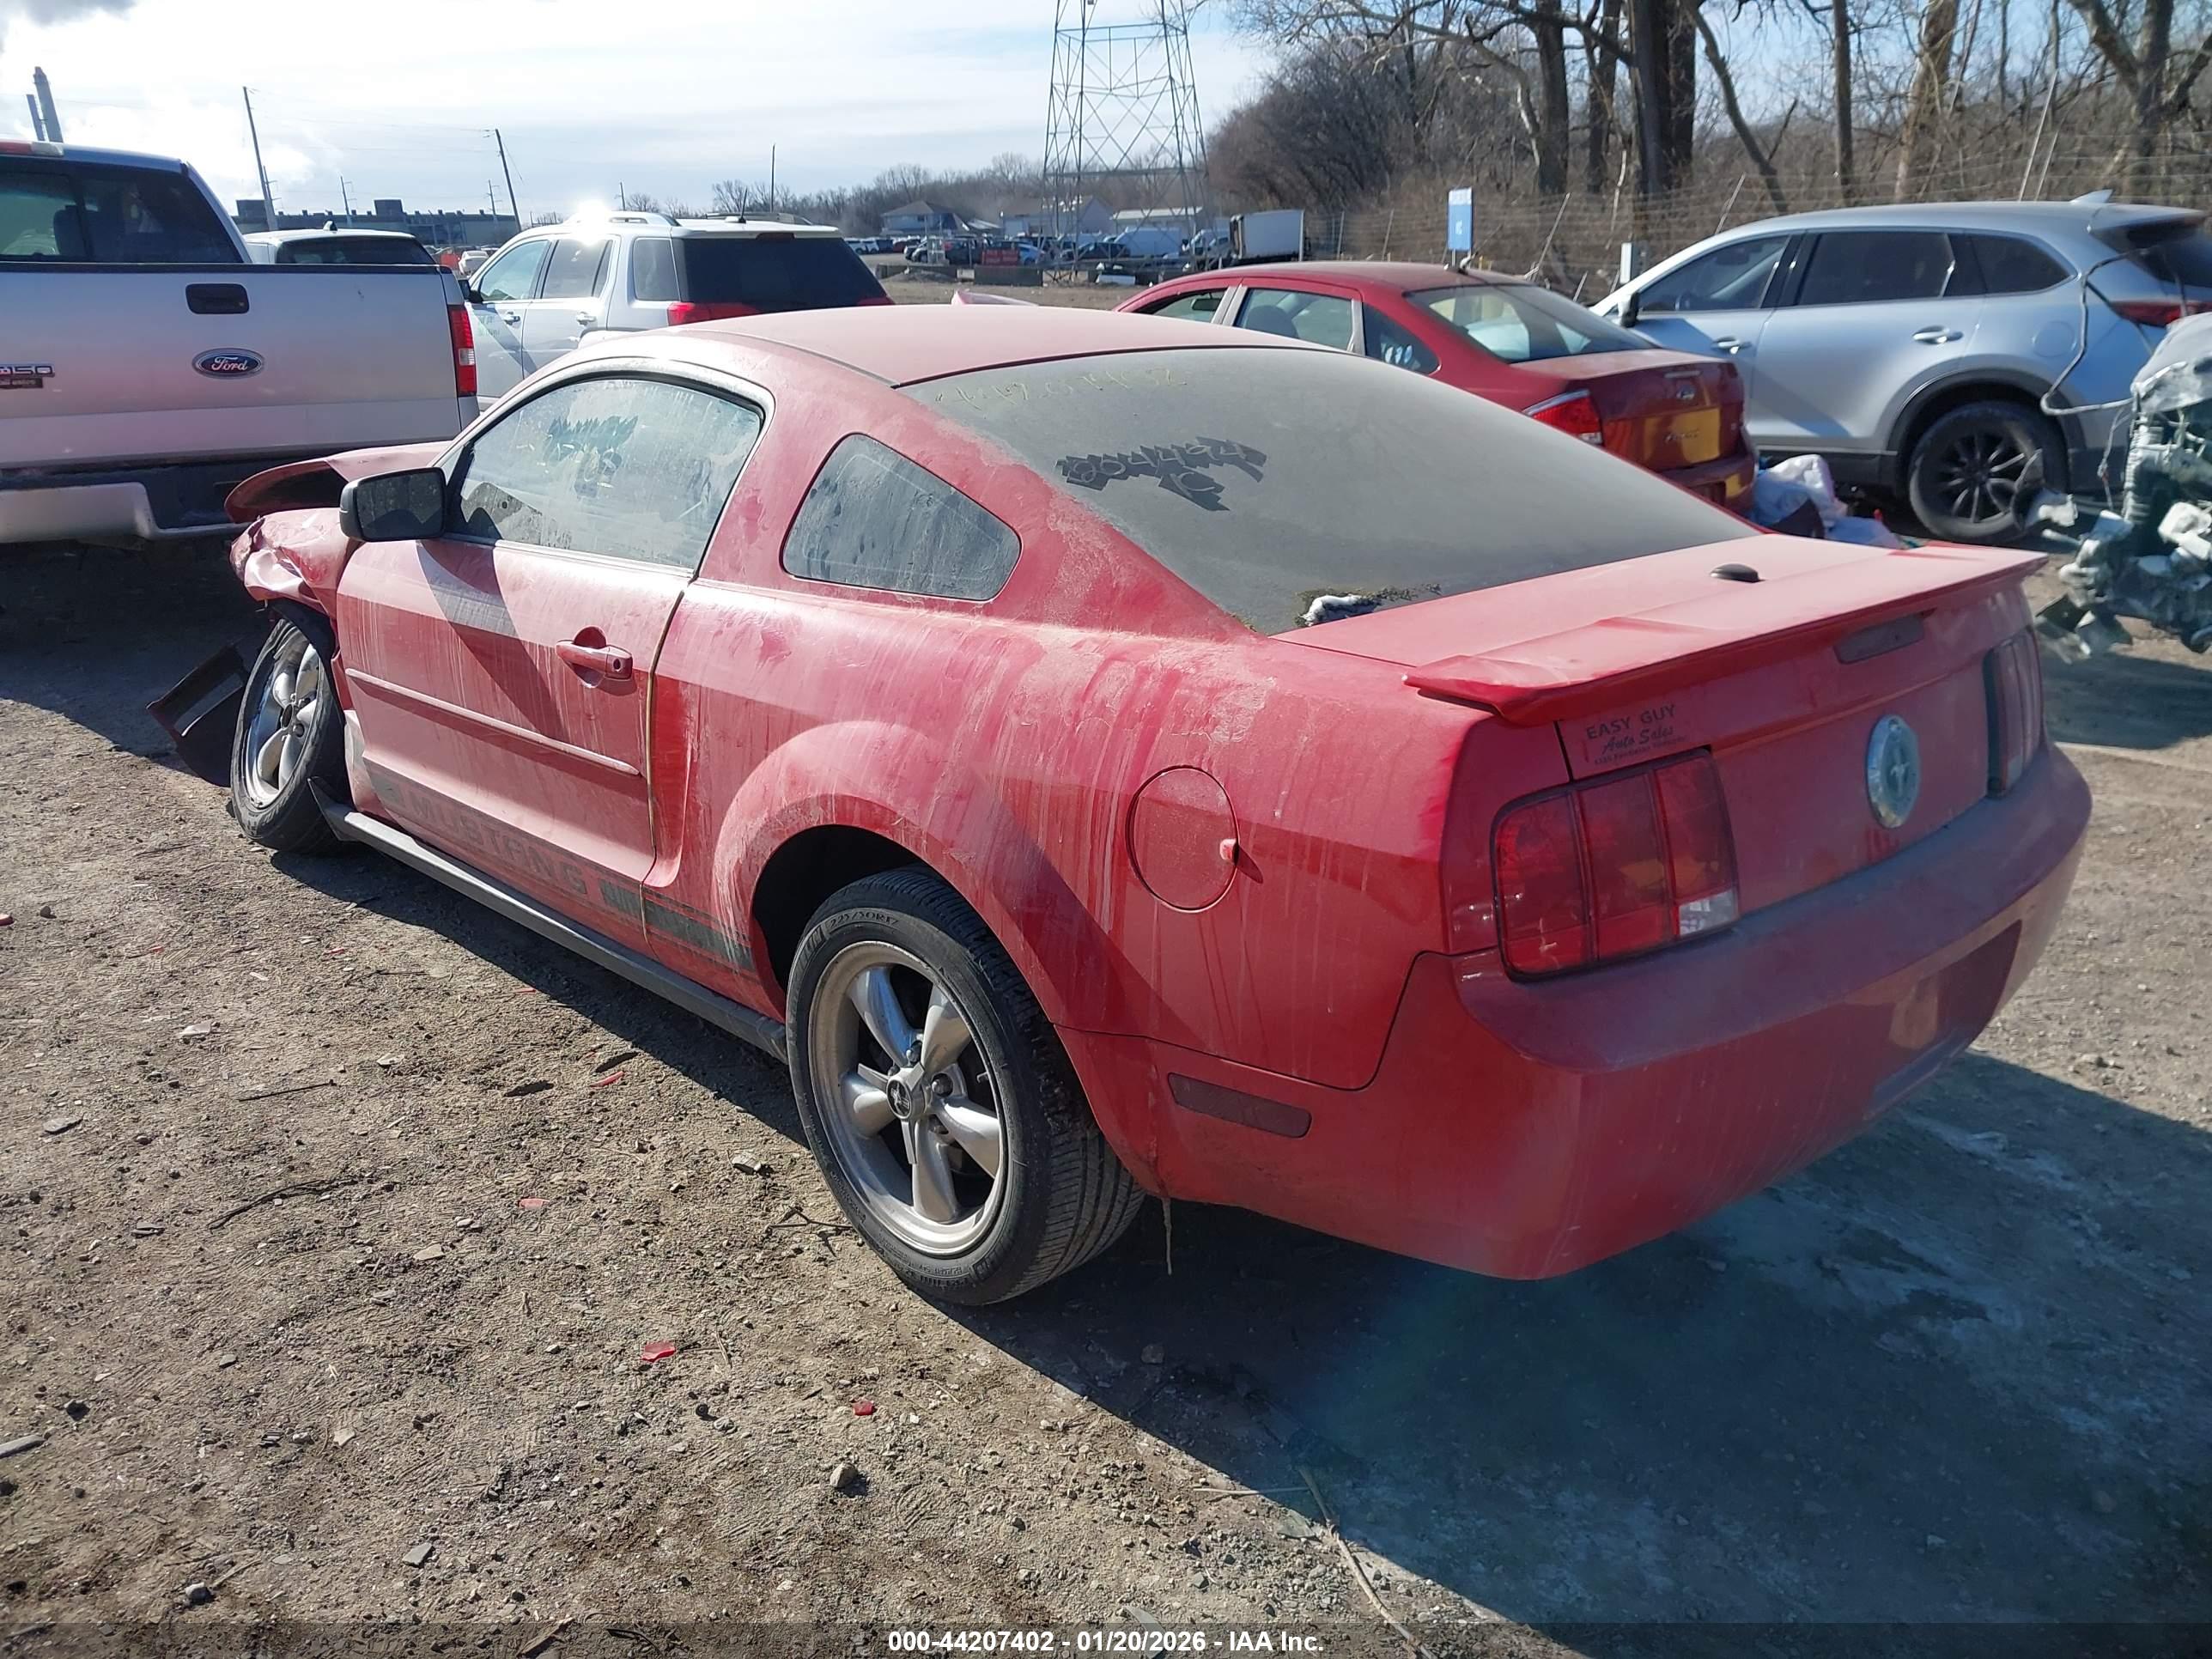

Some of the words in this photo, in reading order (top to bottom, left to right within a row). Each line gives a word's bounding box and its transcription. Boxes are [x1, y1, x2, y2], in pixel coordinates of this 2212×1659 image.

[211, 356, 248, 371] Ford
[1586, 715, 1631, 739] EASY
[1640, 704, 1676, 724] GUY
[1601, 736, 1635, 755] Auto
[1639, 726, 1674, 744] Sales
